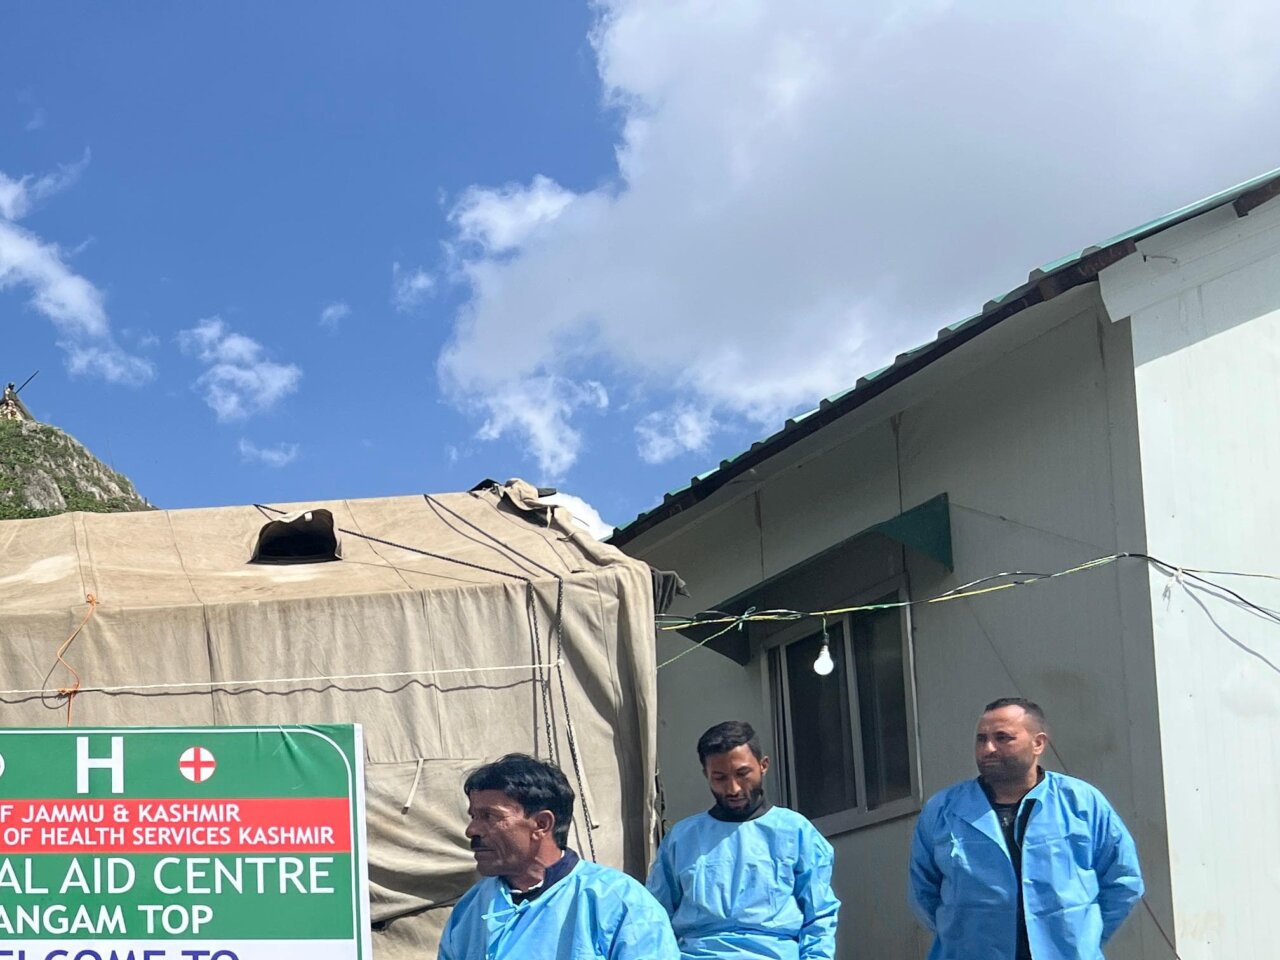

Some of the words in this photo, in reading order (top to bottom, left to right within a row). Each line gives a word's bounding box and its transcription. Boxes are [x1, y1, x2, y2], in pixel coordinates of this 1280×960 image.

[76, 736, 124, 794] H
[21, 805, 104, 824] JAMMU
[138, 804, 241, 823] KASHMIR
[3, 828, 32, 846] OF
[41, 828, 125, 846] HEALTH
[132, 827, 231, 845] SERVICES
[238, 827, 335, 845] KASHMIR
[59, 858, 136, 894] AID
[153, 857, 335, 894] CENTRE
[138, 905, 214, 934] TOP
